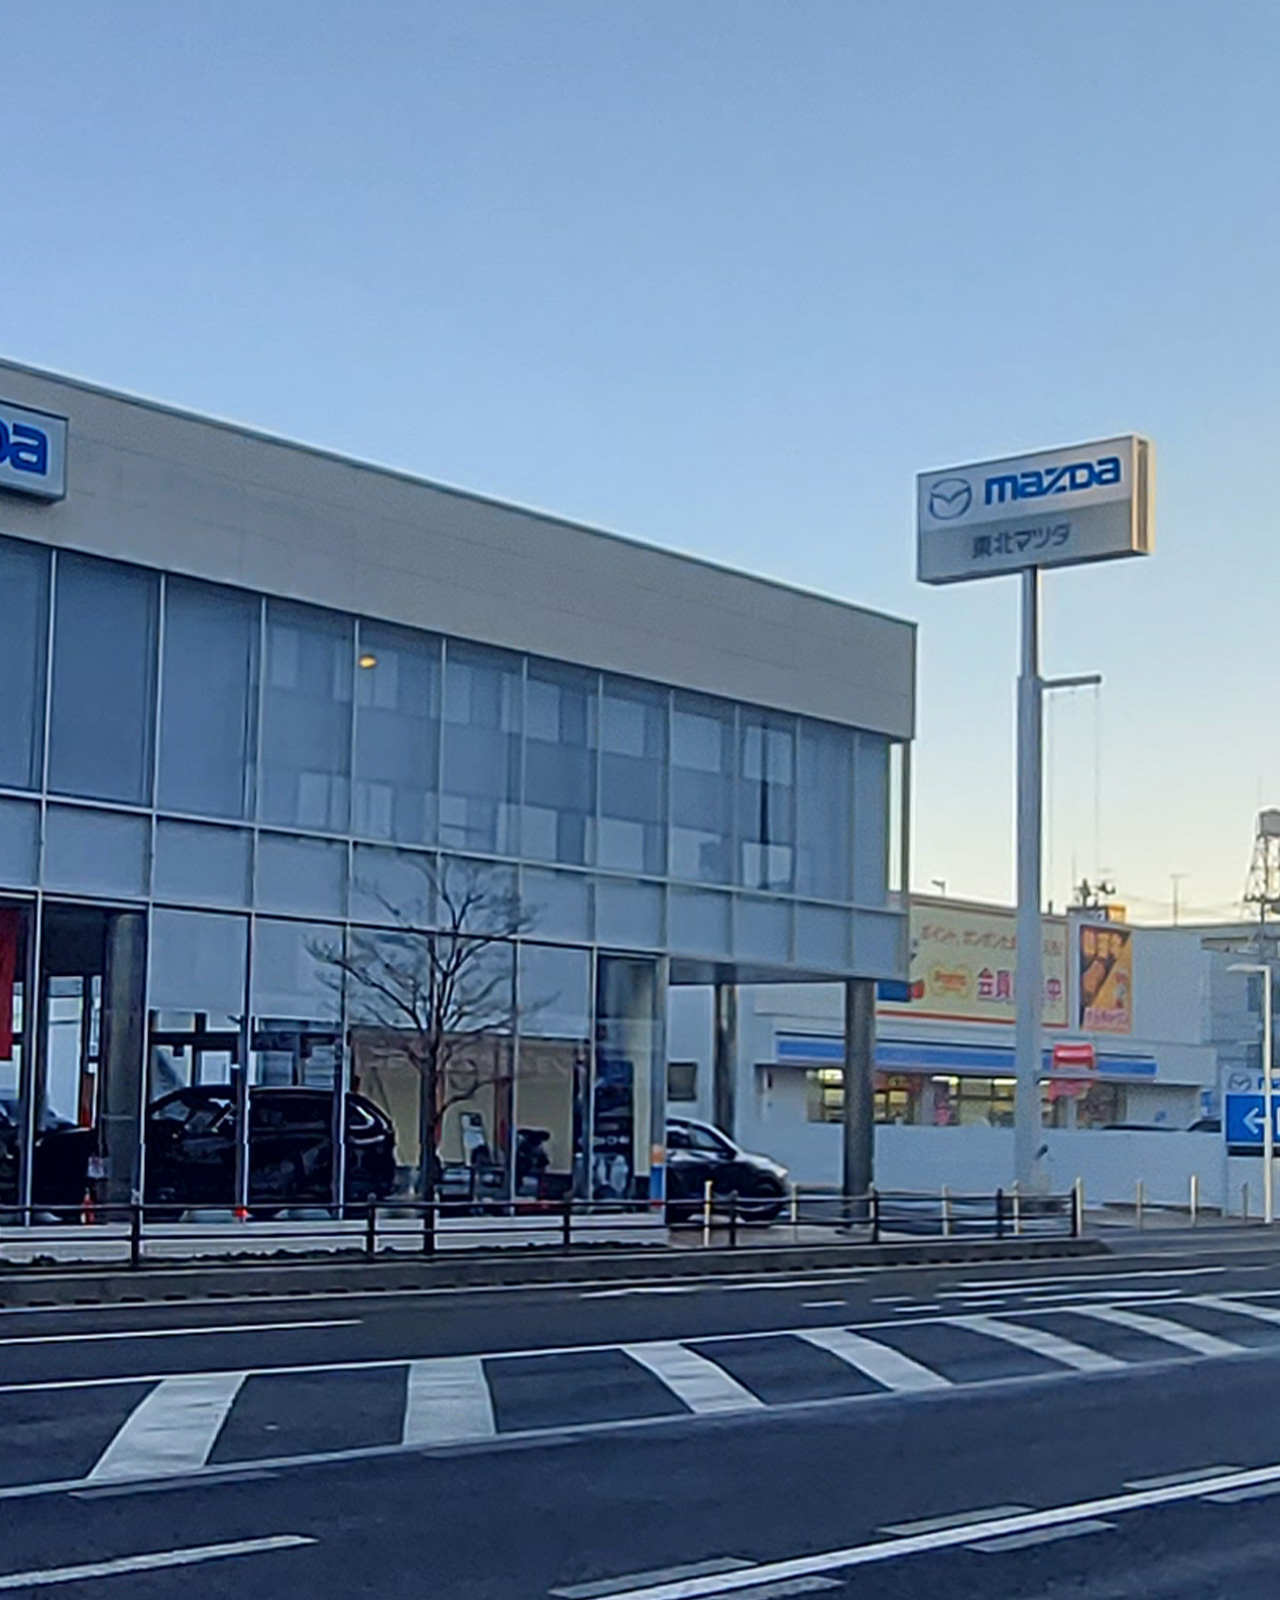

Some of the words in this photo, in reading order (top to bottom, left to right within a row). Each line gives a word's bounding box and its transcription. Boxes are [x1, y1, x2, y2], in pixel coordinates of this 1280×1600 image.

[971, 523, 1072, 559] 東北マツダ
